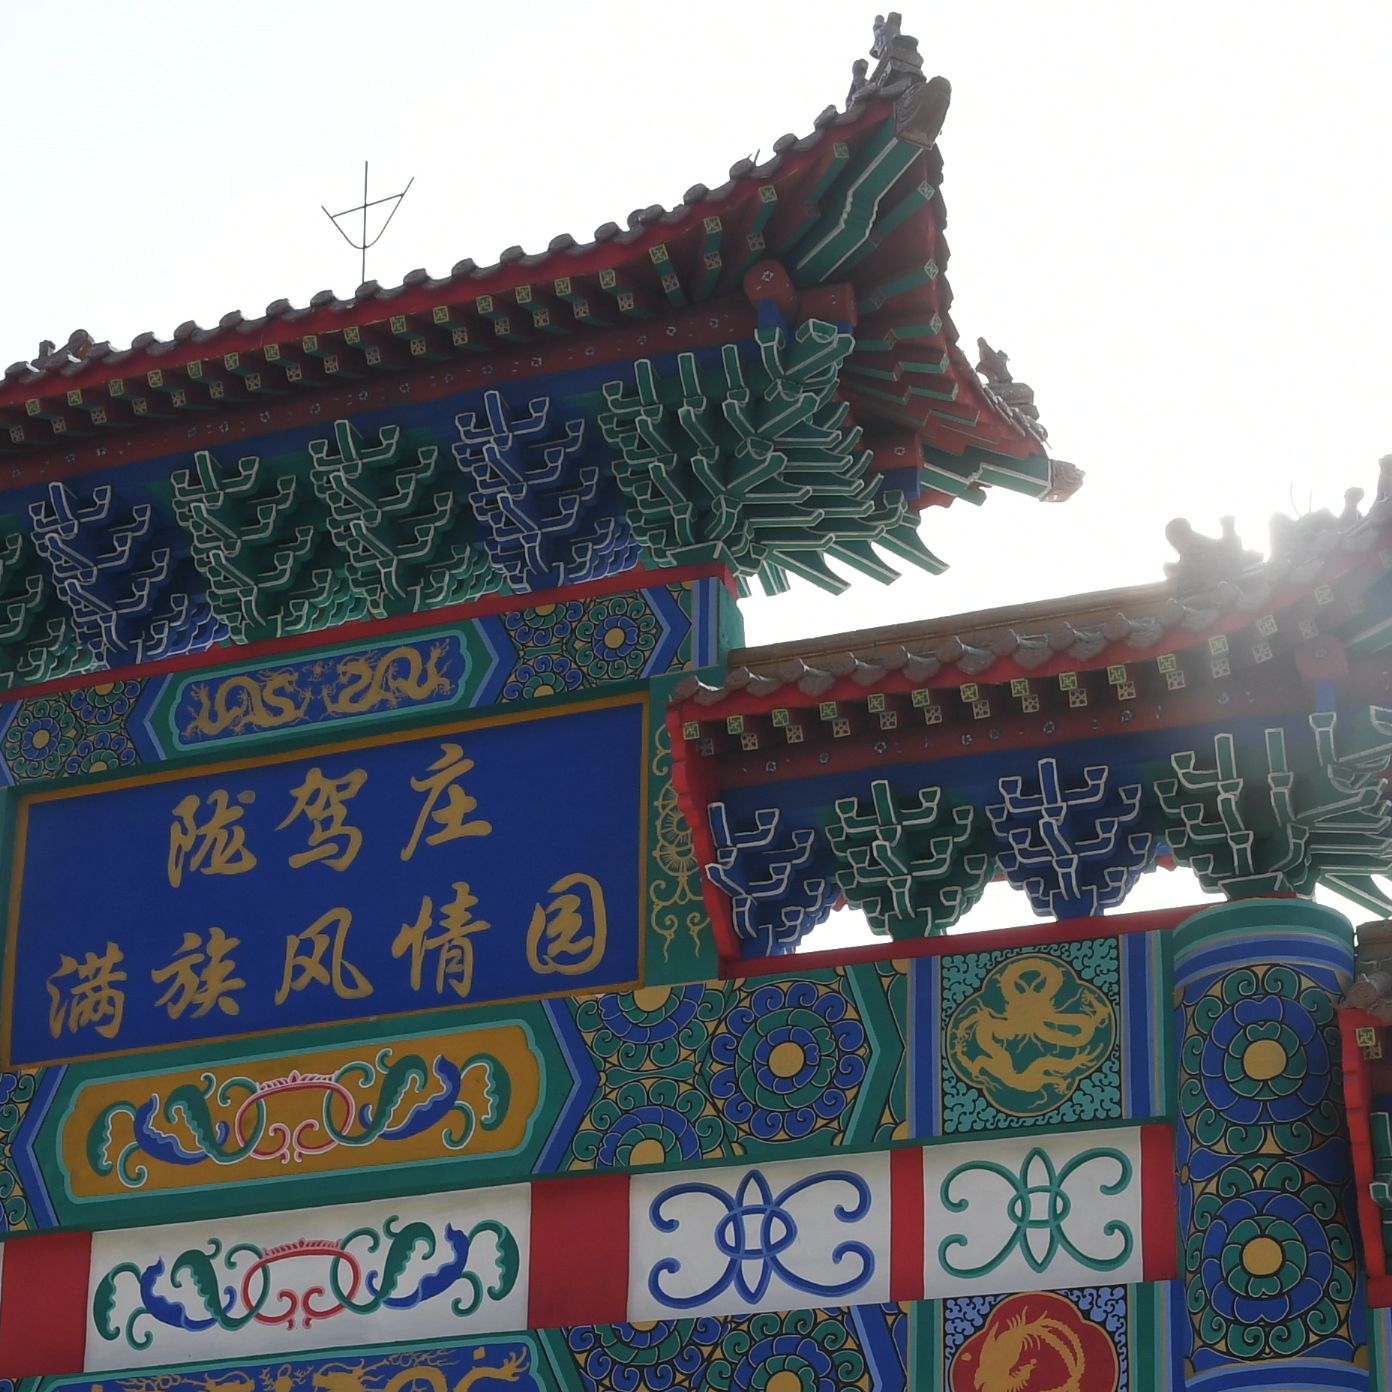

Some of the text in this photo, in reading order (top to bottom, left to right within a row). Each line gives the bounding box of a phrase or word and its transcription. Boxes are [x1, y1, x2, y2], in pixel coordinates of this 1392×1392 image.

[167, 743, 493, 888] 陇驾庄
[46, 872, 608, 1038] 满族风情园
